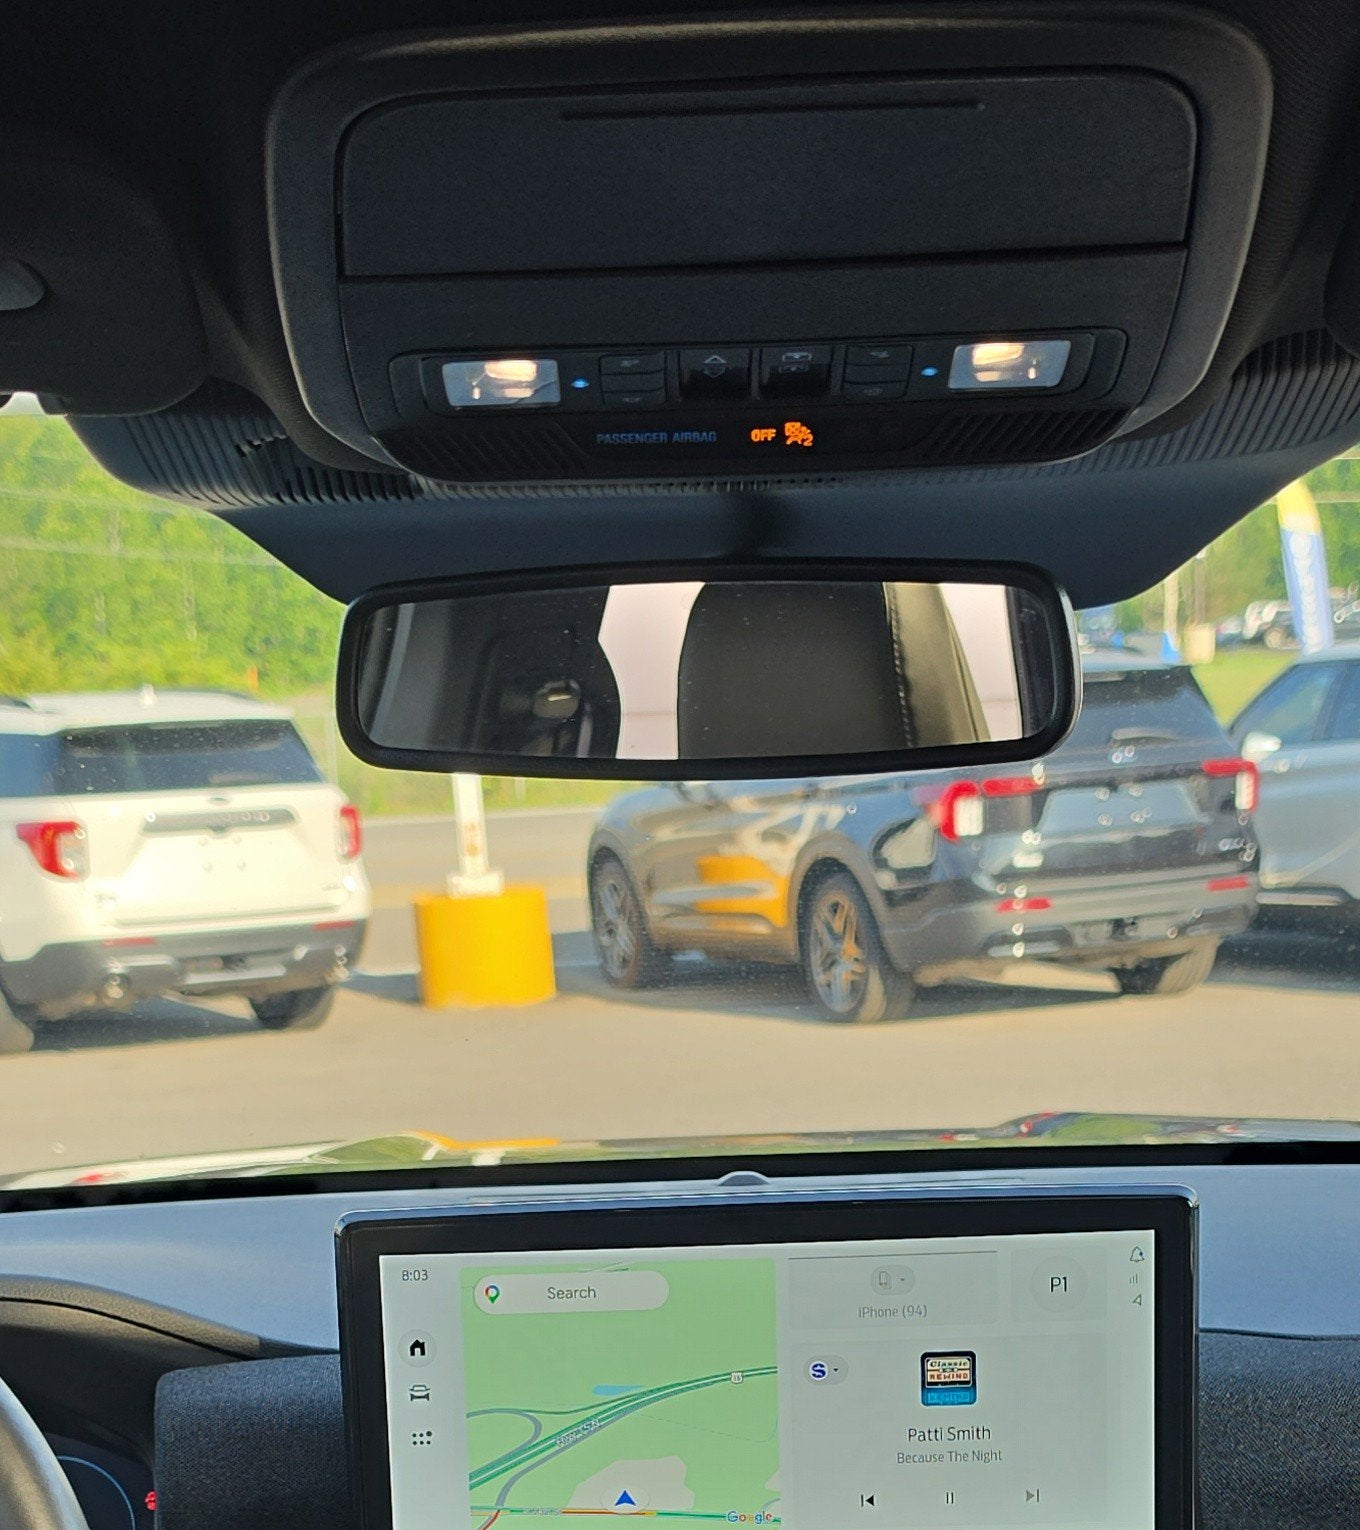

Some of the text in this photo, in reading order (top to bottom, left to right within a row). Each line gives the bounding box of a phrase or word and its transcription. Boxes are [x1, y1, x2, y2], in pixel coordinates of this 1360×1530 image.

[596, 428, 777, 444] PASSENGER AIRBAG OFF
[401, 1269, 429, 1281] 8:03
[1050, 1276, 1068, 1293] P1
[546, 1286, 597, 1300] Search
[857, 1304, 928, 1319] iPhone (94)
[929, 1372, 969, 1381] REWIND
[907, 1425, 992, 1443] Patti Smith
[896, 1448, 1003, 1465] Because The Night
[726, 1511, 774, 1525] Google
